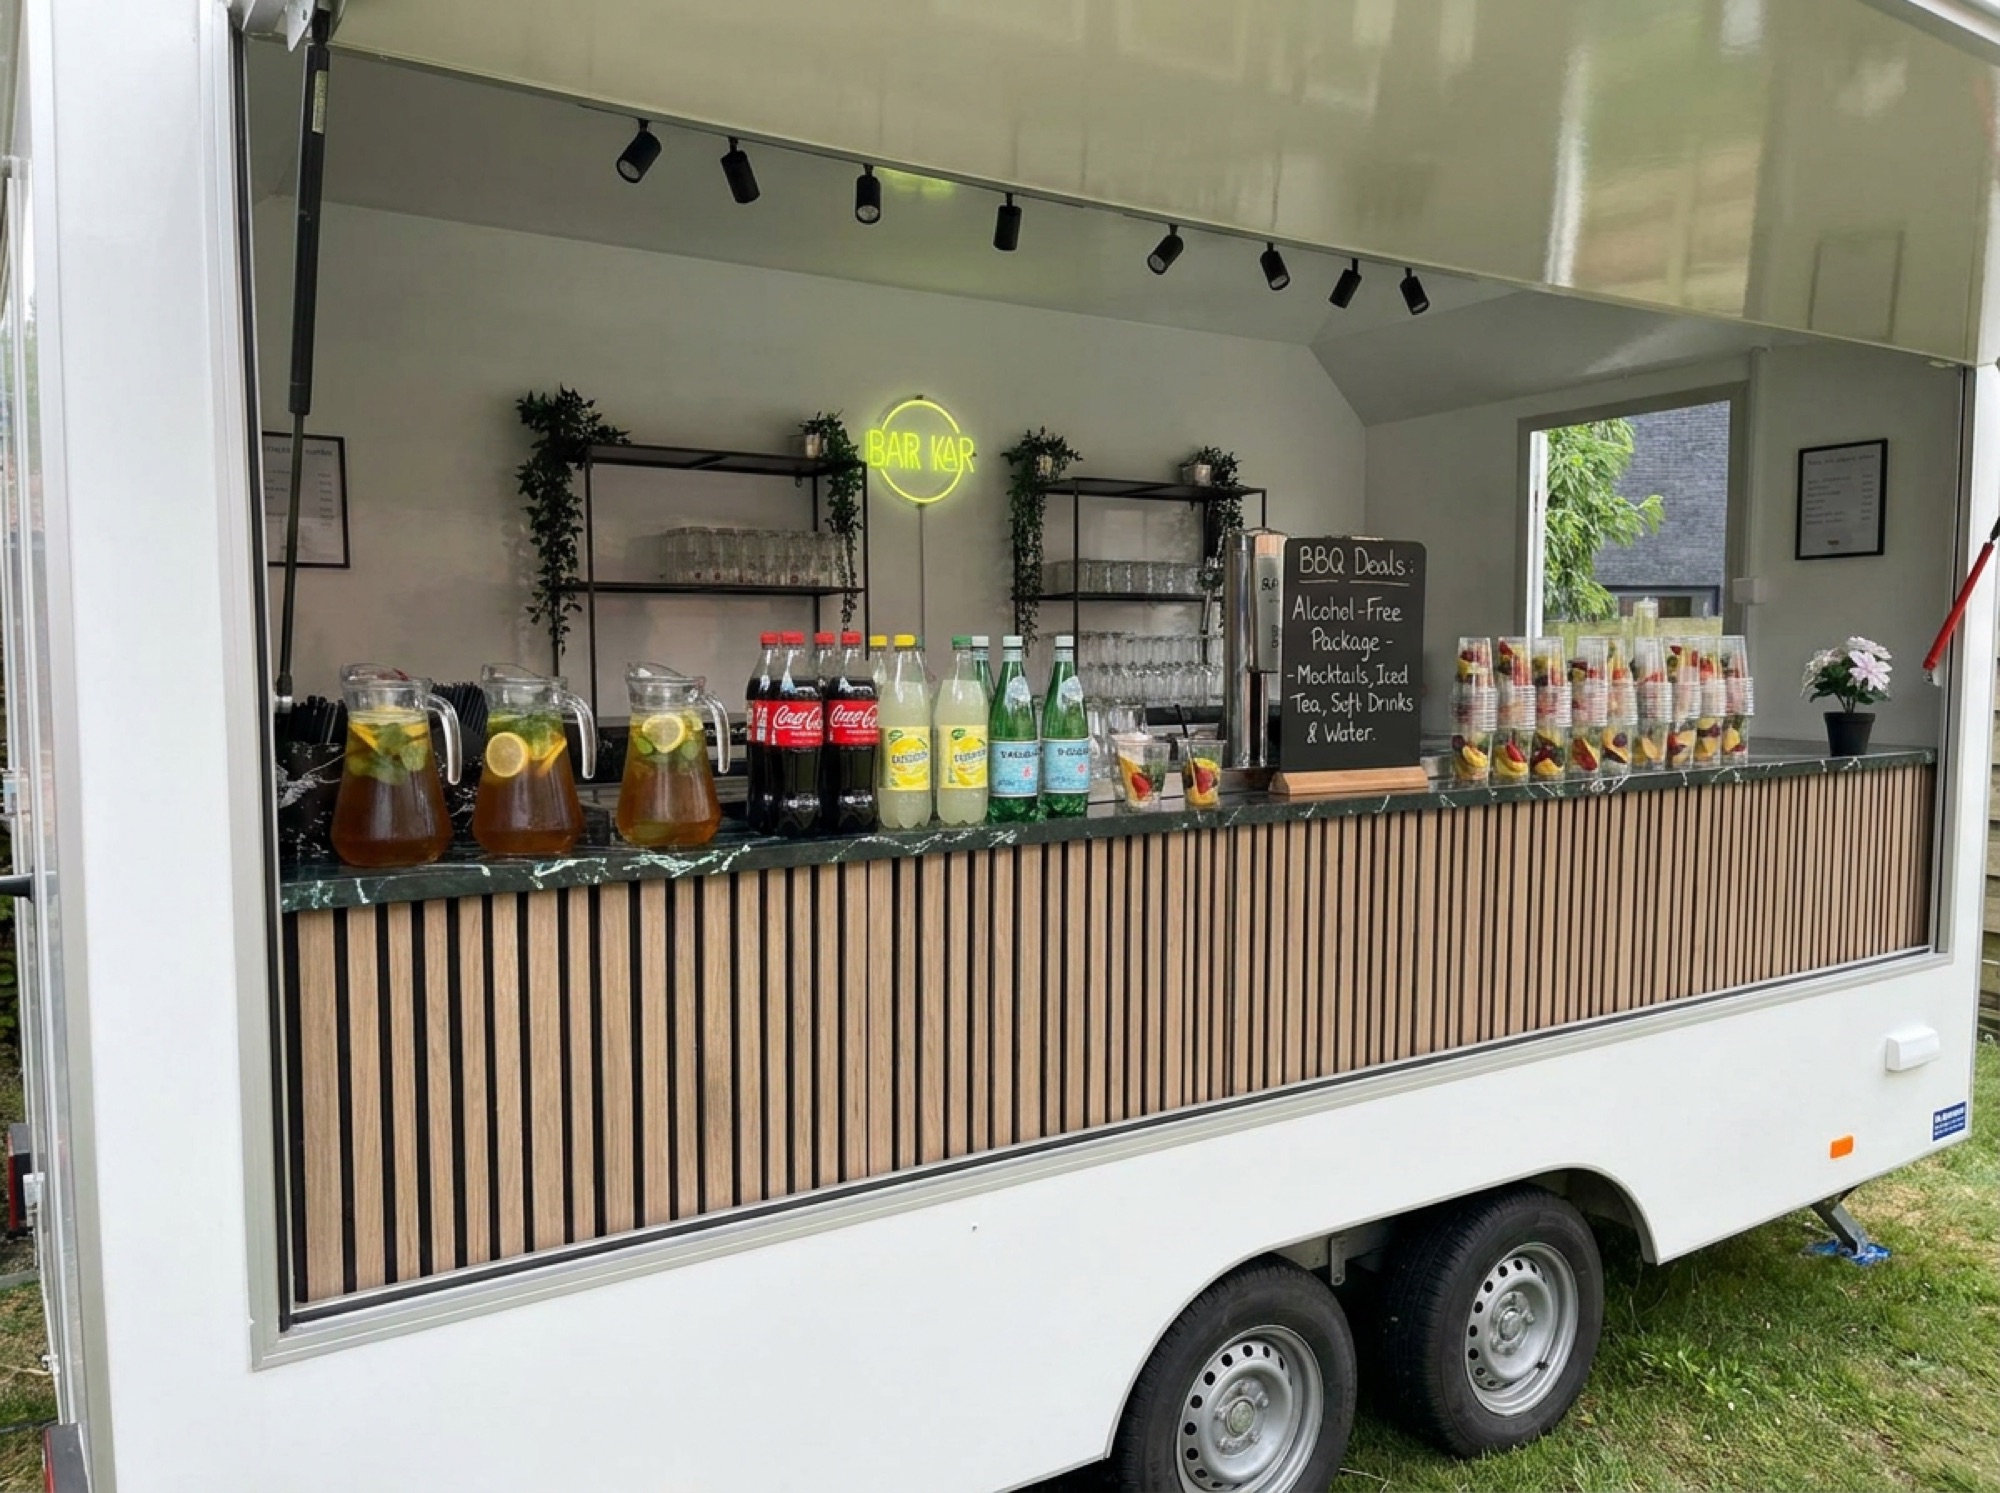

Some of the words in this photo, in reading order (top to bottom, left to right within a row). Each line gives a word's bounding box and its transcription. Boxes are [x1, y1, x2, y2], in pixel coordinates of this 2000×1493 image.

[865, 429, 921, 470] BAR
[931, 434, 975, 473] KAR
[1300, 545, 1344, 575] BBQ
[1292, 594, 1403, 621] Alcohol-Free
[1311, 626, 1381, 662] Package
[1376, 663, 1409, 685] Iced
[1289, 692, 1328, 717] Tea,
[1331, 691, 1362, 718] Soft
[1368, 692, 1414, 712] Drinks
[1306, 721, 1317, 743] &
[1323, 721, 1376, 742] Water.
